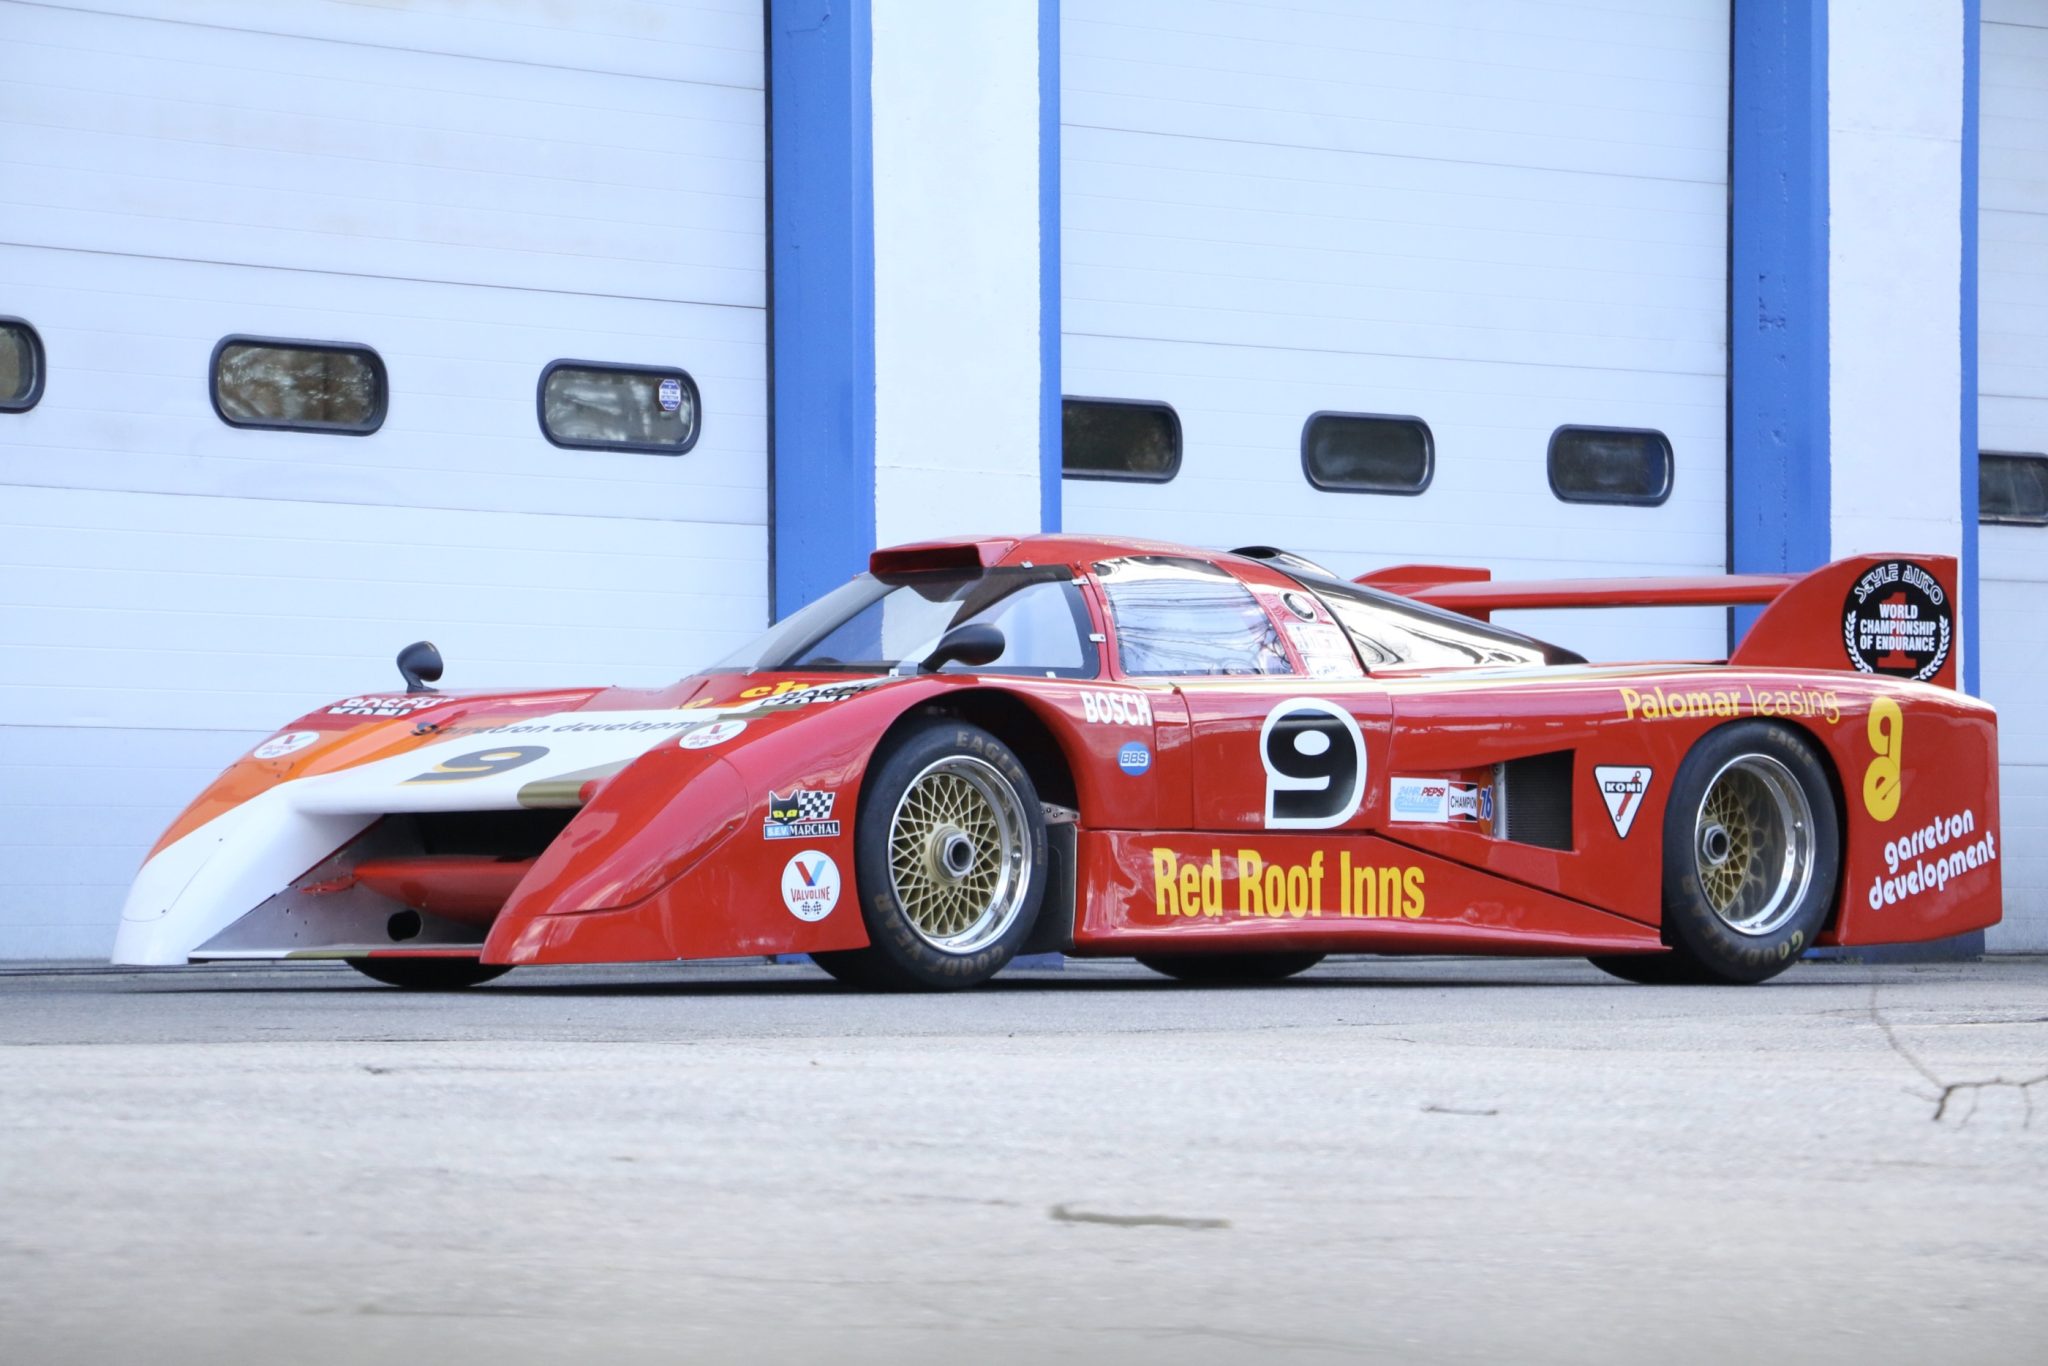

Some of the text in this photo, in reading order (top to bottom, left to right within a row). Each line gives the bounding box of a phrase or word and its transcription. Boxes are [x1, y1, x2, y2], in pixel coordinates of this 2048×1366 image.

[1854, 563, 1944, 605] STYLE AUTO
[1860, 619, 1937, 636] CHAMPIONSHIP
[1879, 603, 1918, 619] WORLD
[1860, 634, 1936, 652] OF ENDURANCE
[1080, 690, 1153, 727] BOSCH
[1619, 684, 1840, 724] Palomar leasing
[400, 745, 551, 785] 9
[956, 730, 1024, 783] EAGLE
[1120, 751, 1148, 765] BBS
[1260, 697, 1367, 829] 9
[1421, 786, 1446, 797] PEPSI
[1450, 794, 1477, 809] CHAMPION
[1480, 785, 1493, 821] 76
[1606, 781, 1643, 793] KONI
[789, 823, 839, 836] MARCHAL
[1884, 809, 1975, 875] garretson
[1152, 847, 1426, 920] Red Roof Inns
[1868, 830, 1997, 911] development
[790, 886, 831, 902] VALVOLINE
